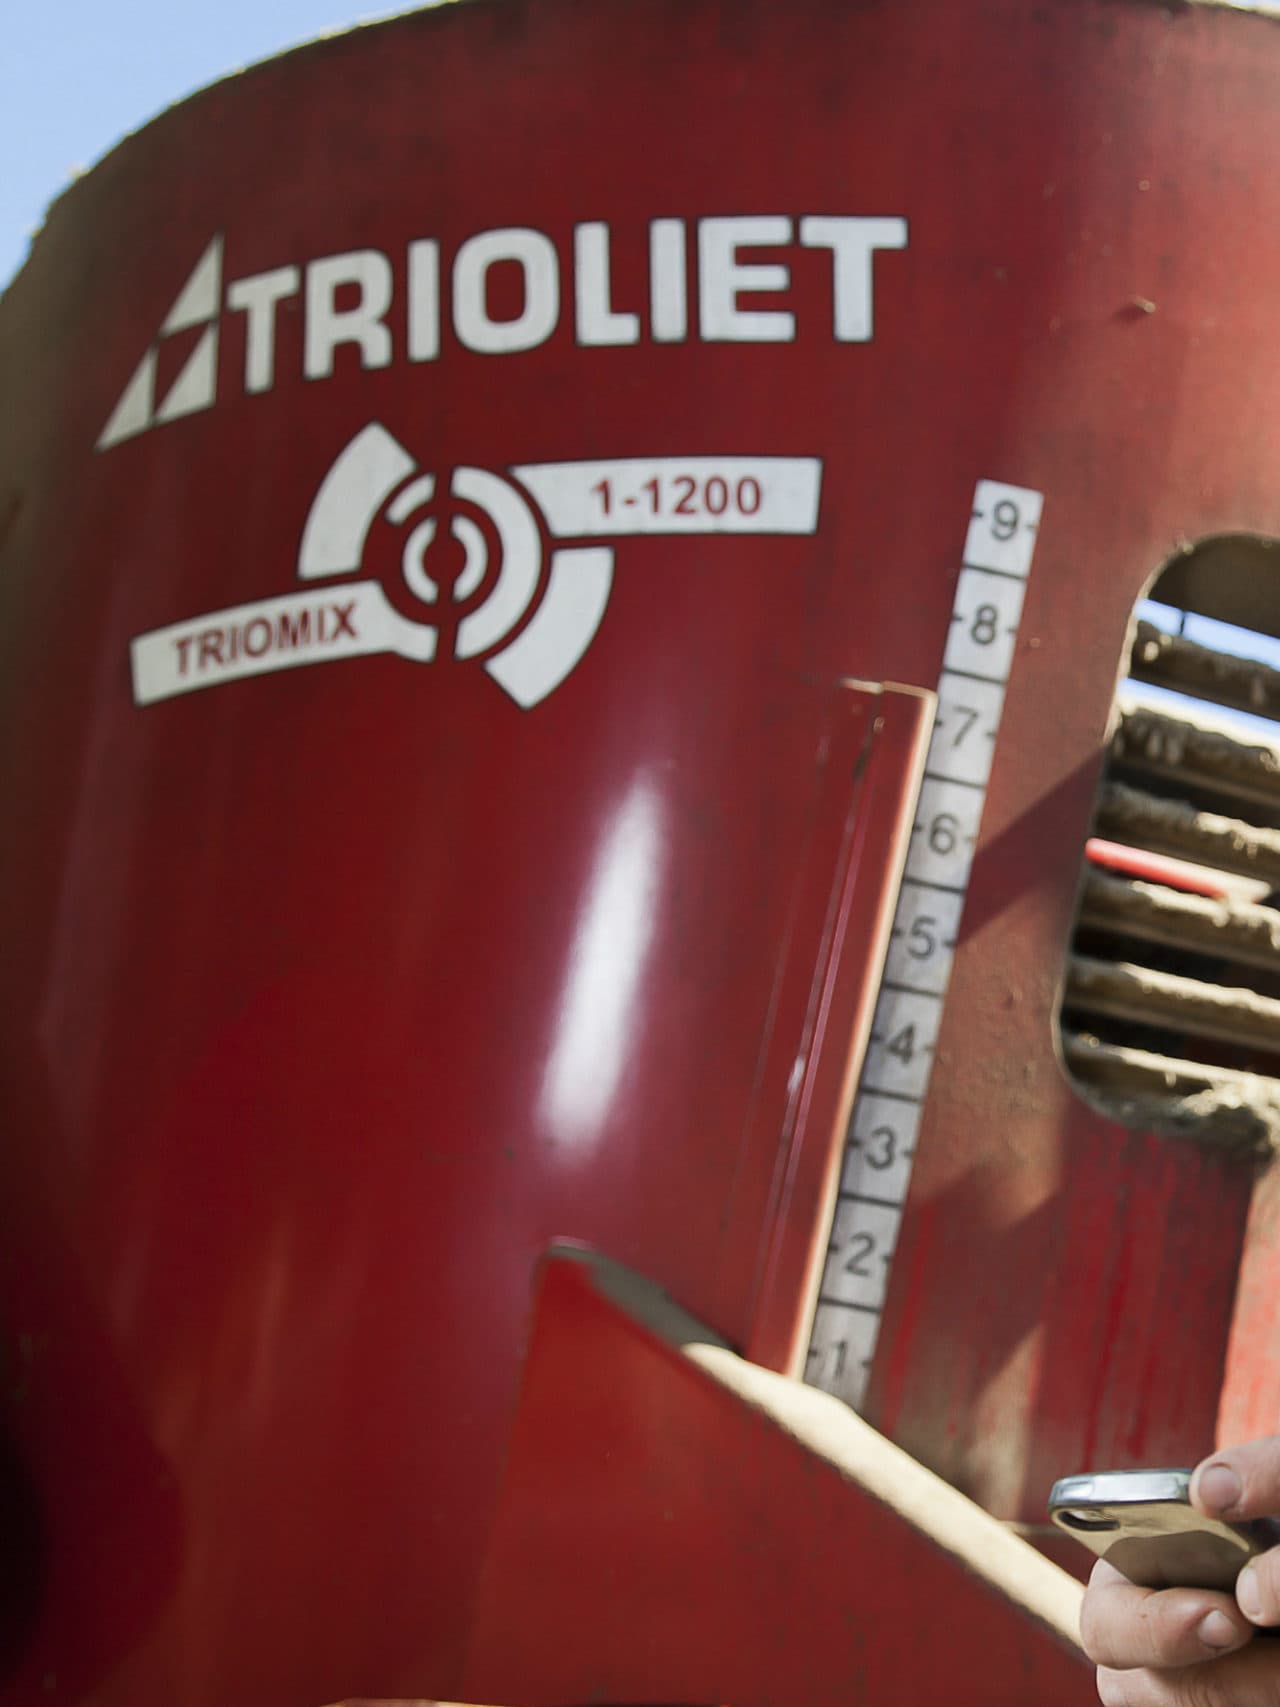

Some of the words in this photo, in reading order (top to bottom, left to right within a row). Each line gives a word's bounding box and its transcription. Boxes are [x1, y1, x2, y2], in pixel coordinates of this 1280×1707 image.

[228, 215, 907, 394] TRIOLIET
[591, 475, 763, 516] 1-1200
[990, 500, 1020, 541] 9
[173, 600, 360, 676] TRIOMIX
[970, 604, 998, 646] 8
[952, 706, 980, 748] 7
[928, 813, 956, 856] 6
[907, 916, 938, 960] 5
[885, 1022, 916, 1066] 4
[864, 1127, 897, 1170] 3
[844, 1231, 876, 1277] 2
[831, 1340, 848, 1379] 1
